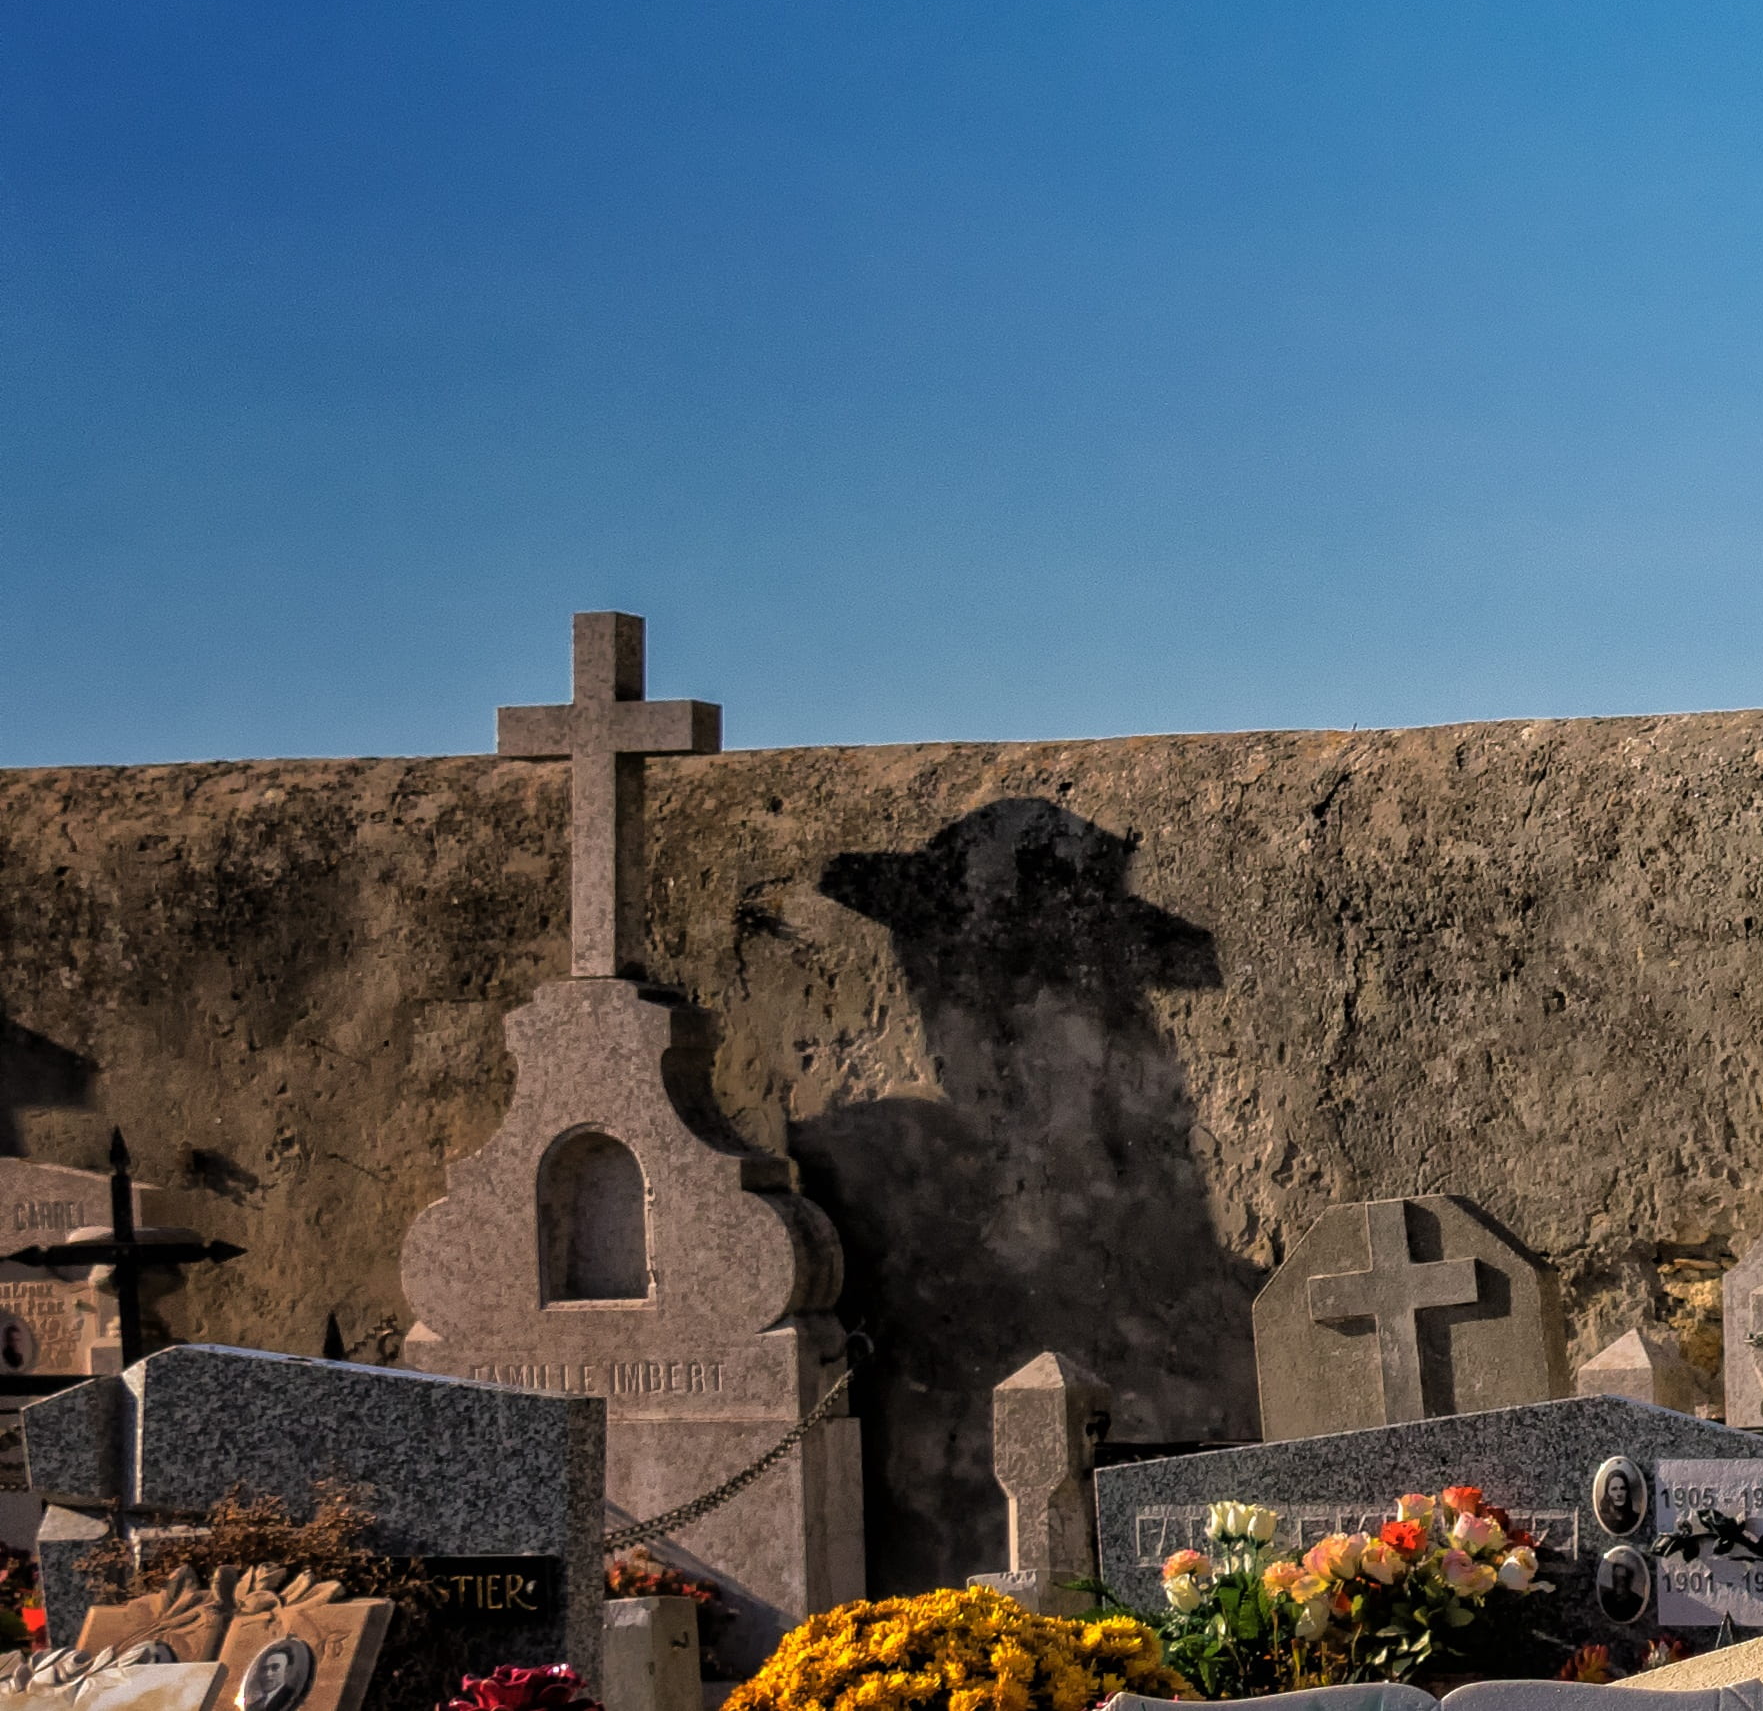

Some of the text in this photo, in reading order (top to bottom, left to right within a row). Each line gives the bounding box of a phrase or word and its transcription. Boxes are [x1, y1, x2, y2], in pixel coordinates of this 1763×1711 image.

[611, 1362, 726, 1393] IMBERT
[1660, 1487, 1715, 1509] 1905
[1662, 1572, 1714, 1593] 1901
